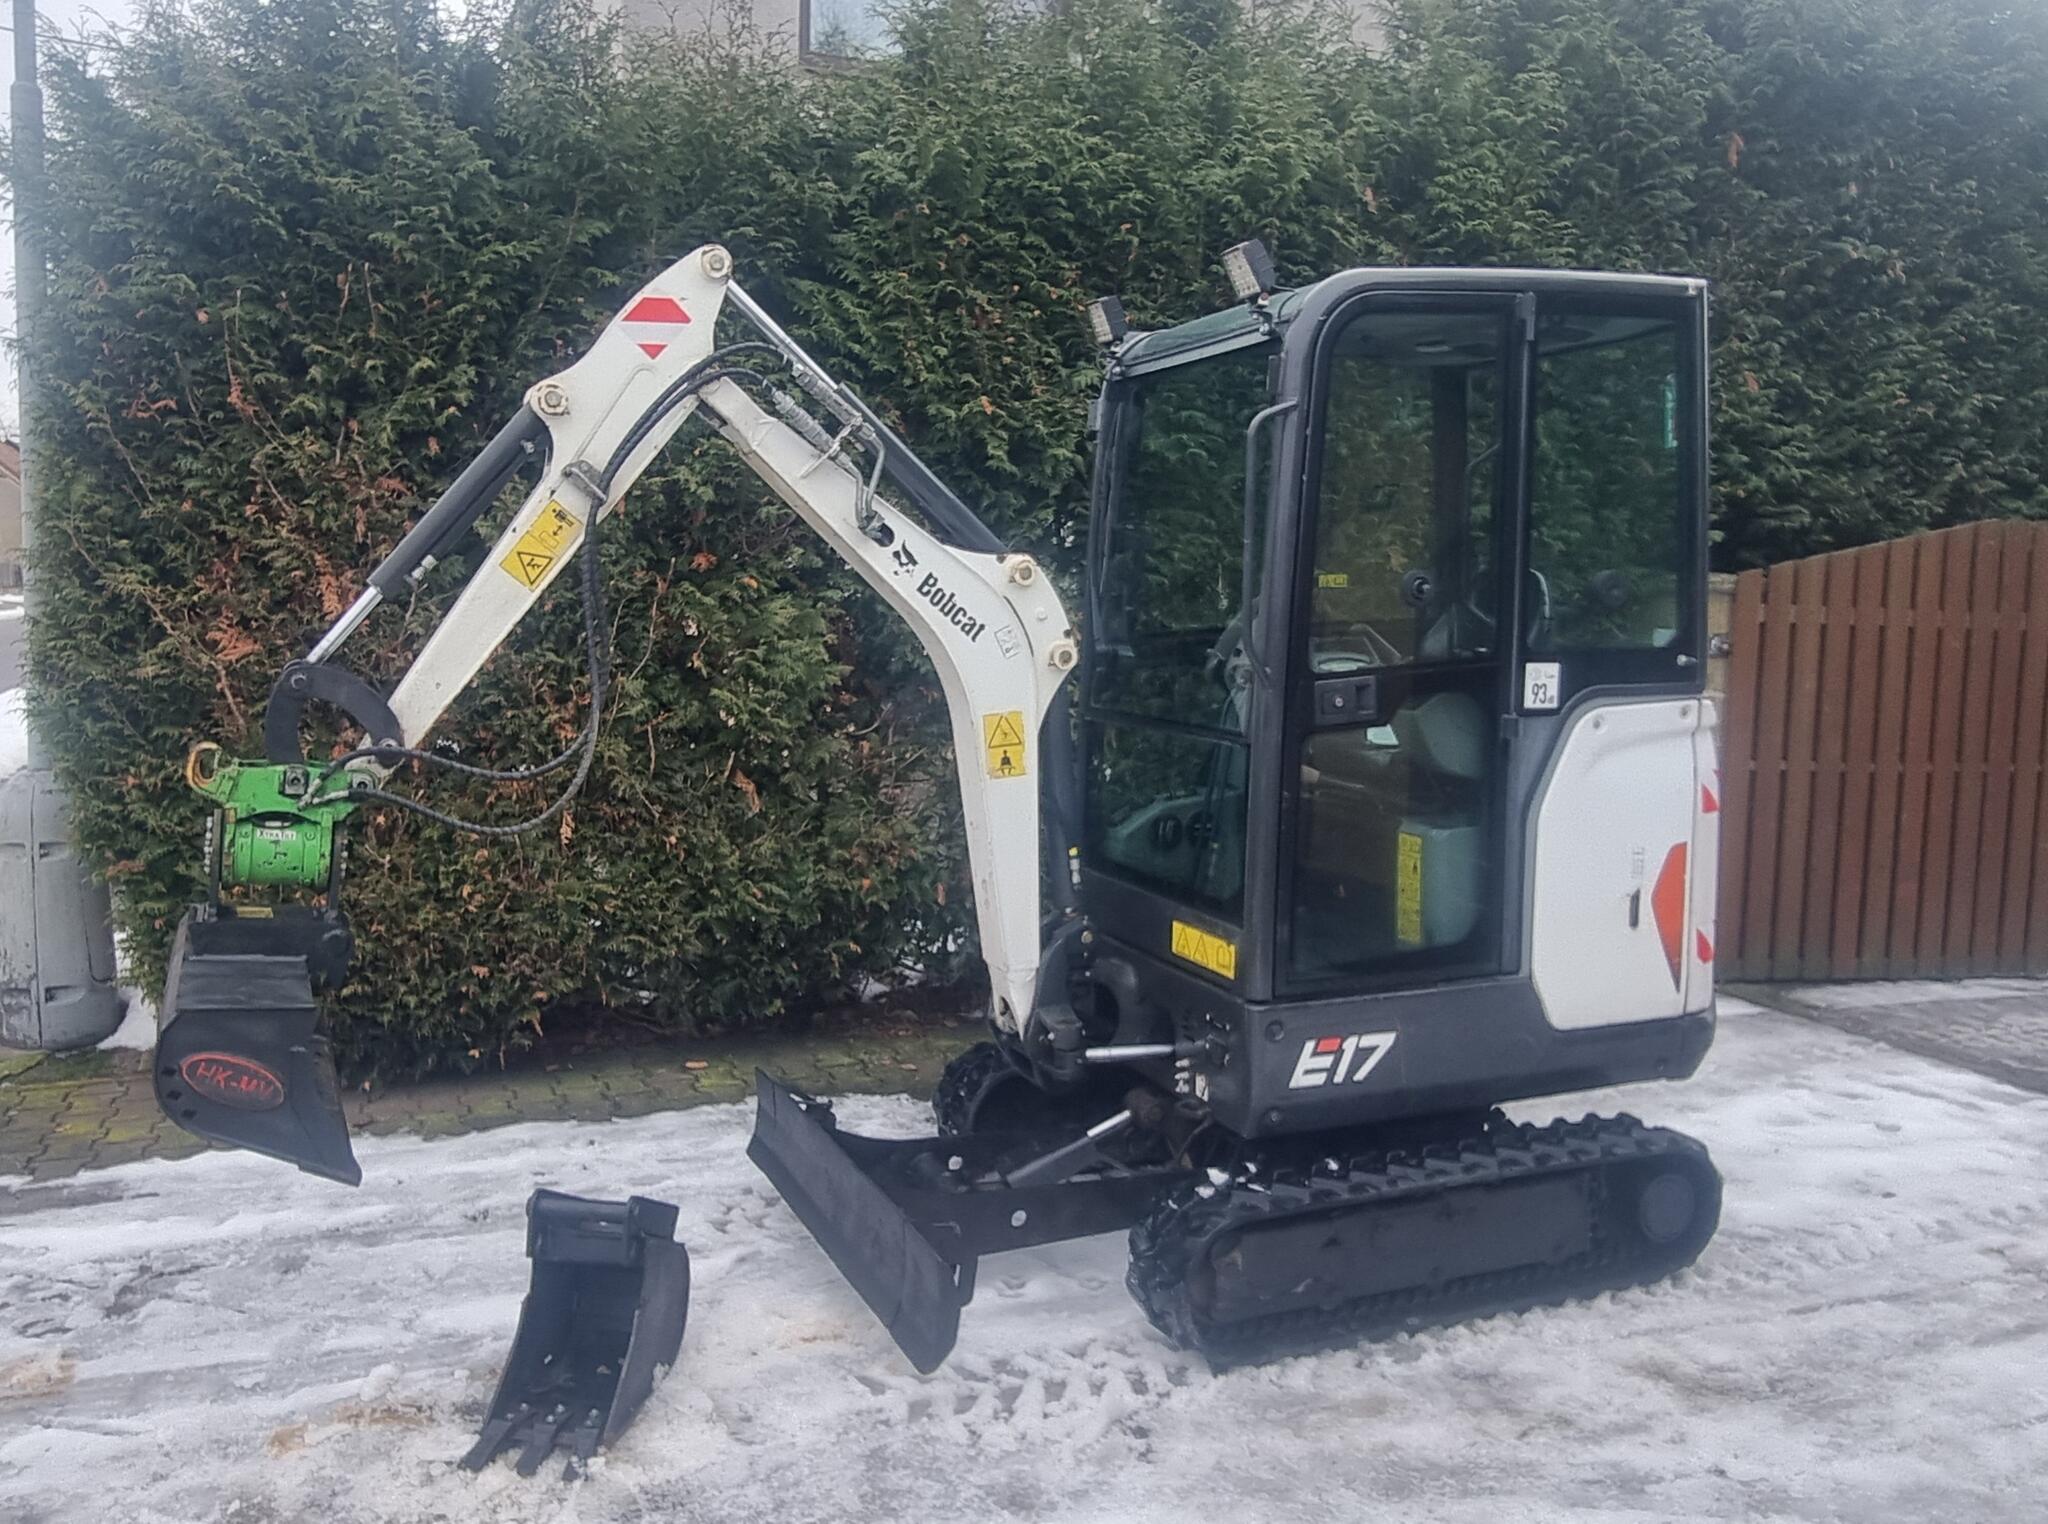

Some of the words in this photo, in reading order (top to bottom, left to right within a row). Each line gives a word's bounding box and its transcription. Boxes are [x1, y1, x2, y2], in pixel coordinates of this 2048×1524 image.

[916, 572, 986, 643] Bobcat
[1531, 683, 1547, 705] 93
[1288, 1031, 1397, 1090] E17
